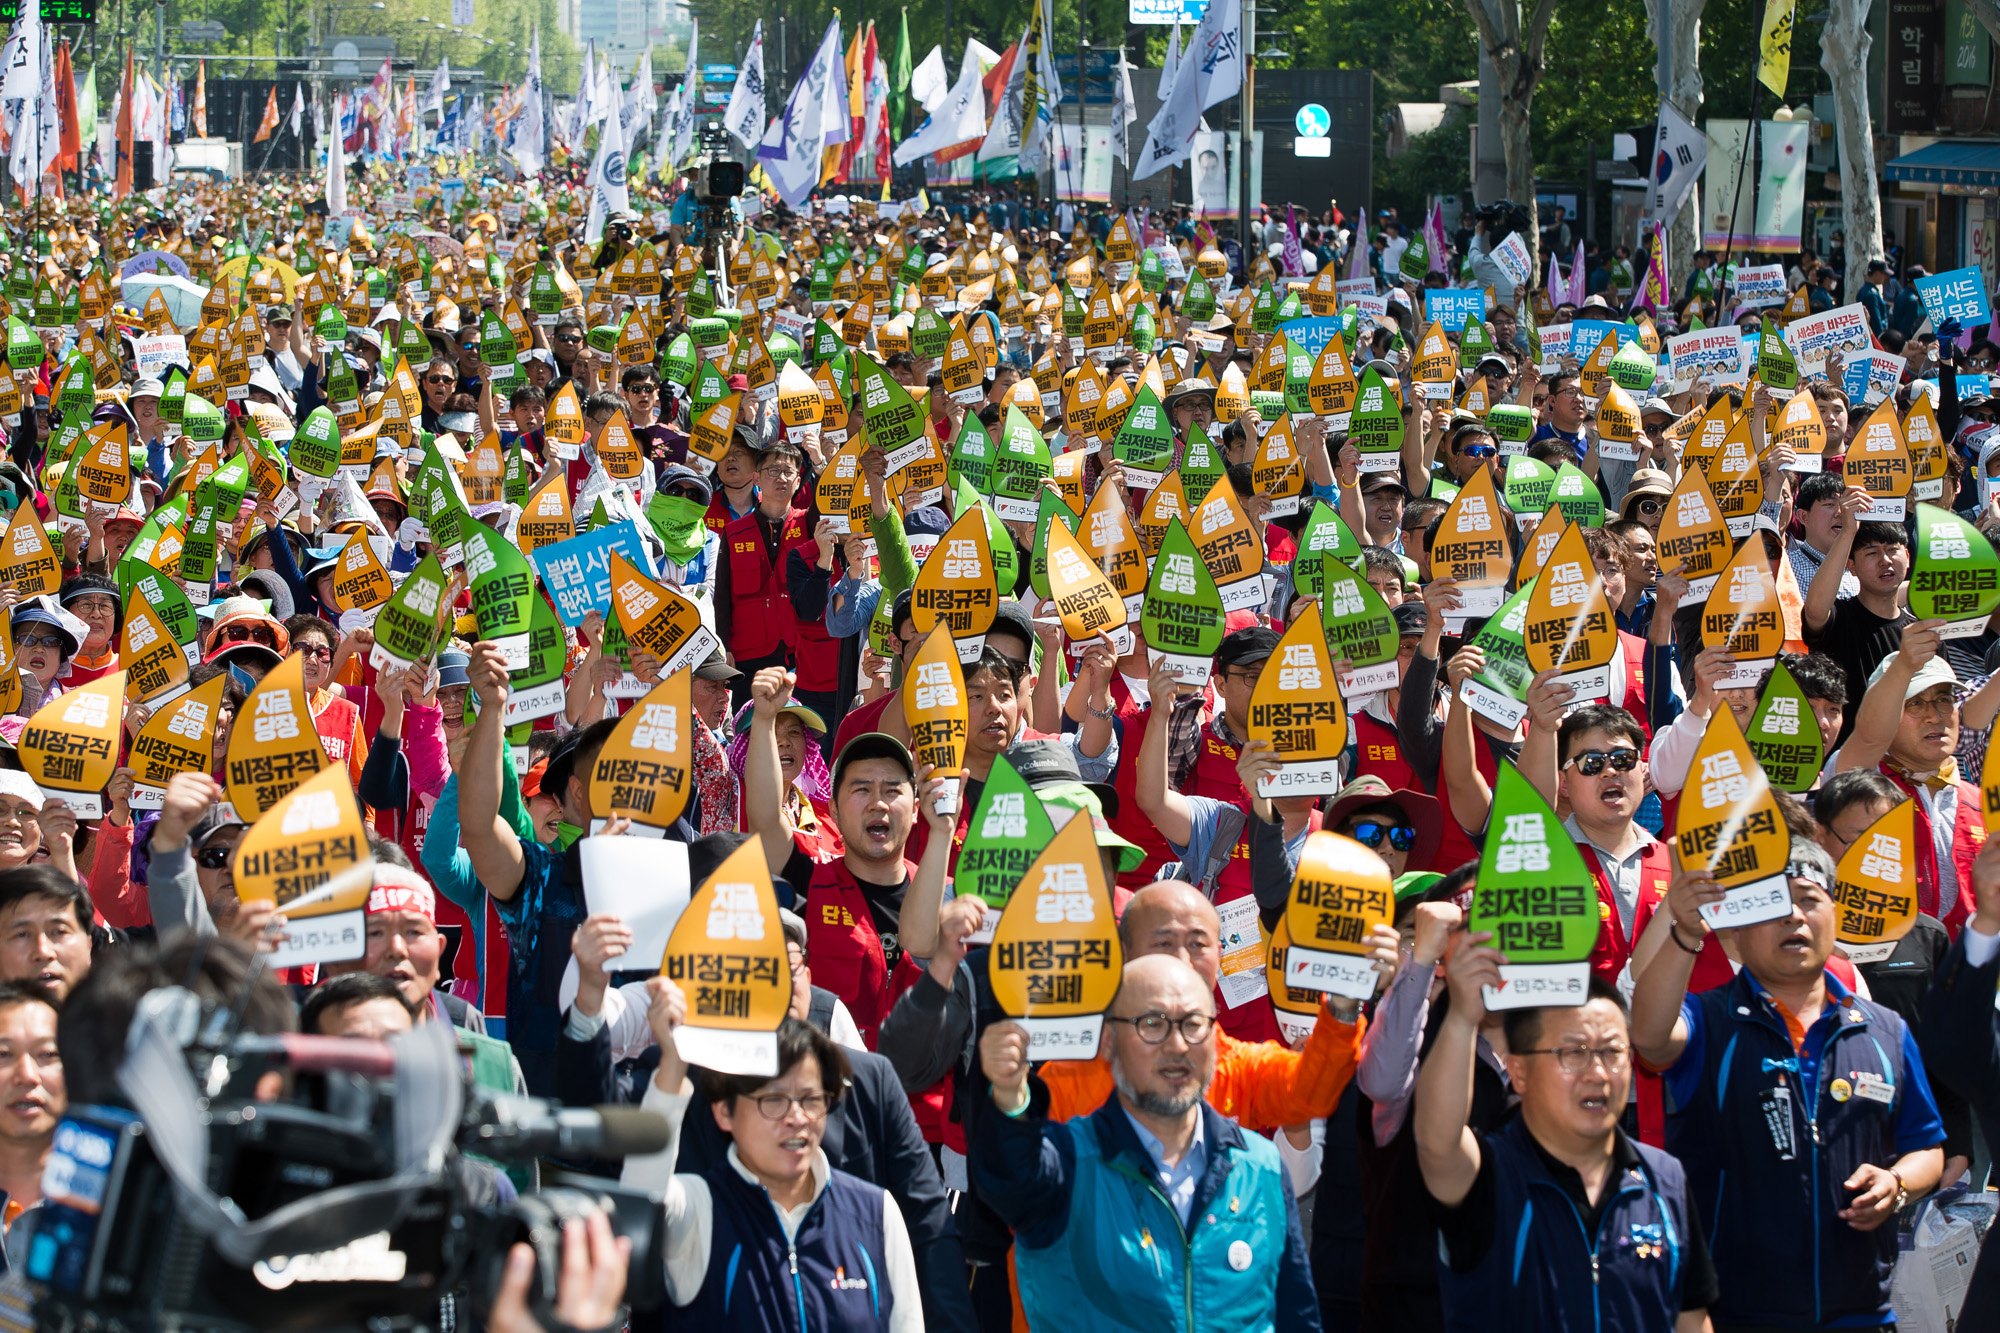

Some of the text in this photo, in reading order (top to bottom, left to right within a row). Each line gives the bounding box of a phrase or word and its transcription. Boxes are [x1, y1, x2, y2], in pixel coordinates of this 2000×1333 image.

[1901, 27, 1925, 85] 학림
[1431, 297, 1480, 311] 불법 사드
[1921, 280, 1978, 308] 불법 사드
[1948, 300, 1982, 321] 무효
[1309, 325, 1335, 344] 사드
[1576, 328, 1602, 344] 불법
[1797, 314, 1861, 339] 세상을 바꾸는
[1800, 325, 1864, 348] 공공운수노동자
[481, 340, 514, 355] 최저임금
[951, 348, 970, 361] 당장
[1673, 335, 1737, 356] 세상을 바꾸는
[1674, 347, 1739, 369] 공공운수노동자
[942, 359, 979, 380] 비정규직
[1413, 356, 1451, 375] 비정규직
[1760, 356, 1794, 374] 최저임금
[865, 389, 891, 409] 당장
[1310, 380, 1355, 399] 비정규직
[1363, 386, 1383, 400] 지금
[545, 418, 582, 431] 비정규직
[865, 403, 915, 433] 최저임금
[1351, 416, 1399, 433] 최저임금
[103, 441, 122, 456] 지금
[294, 438, 338, 462] 최저임금
[961, 441, 985, 457] 당장
[1118, 433, 1170, 453] 최저임금
[1723, 442, 1747, 457] 지금
[98, 452, 122, 468] 당장
[609, 462, 630, 474] 철폐
[996, 458, 1050, 479] 최저임금
[1721, 456, 1750, 473] 당장
[1847, 458, 1907, 476] 비정규직
[79, 466, 125, 488] 비정규직
[1863, 476, 1893, 492] 철폐
[520, 522, 570, 537] 비정규직
[1202, 510, 1236, 535] 당장
[13, 537, 43, 556] 당장
[182, 539, 213, 559] 최저임금
[464, 532, 489, 561] 지금
[735, 542, 756, 553] 단결
[1434, 540, 1503, 564] 비정규직
[1659, 529, 1725, 559] 비정규직
[1053, 545, 1079, 569] 지금
[336, 568, 385, 595] 비정규직
[545, 553, 585, 592] 불법
[1915, 568, 1998, 592] 최저임금
[351, 587, 378, 608] 철폐
[557, 583, 595, 619] 원천
[1058, 581, 1114, 617] 비정규직
[1332, 578, 1361, 600] 지금
[1550, 582, 1594, 608] 당장
[1146, 597, 1217, 628] 최저임금
[1932, 593, 1980, 615] 1만원
[629, 600, 684, 649] 비정규직
[1080, 606, 1112, 632] 철폐
[1326, 616, 1391, 645] 최저임금
[1528, 612, 1608, 645] 비정규직
[1706, 612, 1776, 633] 비정규직
[129, 628, 159, 654] 당장
[650, 624, 685, 656] 철폐
[1157, 622, 1200, 648] 1만원
[137, 667, 171, 694] 철폐
[916, 661, 953, 686] 지금
[256, 689, 292, 714] 지금
[915, 683, 959, 711] 당장
[1767, 696, 1799, 716] 지금
[253, 711, 300, 742] 당장
[639, 703, 677, 729] 지금
[1252, 701, 1336, 728] 비정규직
[1761, 715, 1801, 735] 당장
[167, 716, 205, 741] 당장
[631, 724, 679, 752] 당장
[1272, 728, 1317, 753] 철폐
[24, 727, 112, 760] 비정규직
[134, 734, 207, 771] 비정규직
[1367, 745, 1396, 761] 단결
[42, 756, 86, 783] 철폐
[230, 749, 320, 786] 비정규직
[596, 758, 686, 793] 비정규직
[1023, 758, 1059, 771] Columbia
[1700, 749, 1740, 781] 지금
[1279, 770, 1334, 786] 민주노총
[610, 785, 657, 815] 철폐
[1701, 773, 1752, 809] 당장
[988, 792, 1025, 816] 지금
[981, 812, 1028, 839] 당장
[1501, 813, 1546, 844] 지금
[1680, 809, 1777, 858] 비정규직
[243, 836, 357, 877] 비정규직
[1495, 843, 1551, 873] 당장
[1867, 833, 1903, 860] 지금
[1040, 864, 1088, 892] 지금
[1860, 853, 1903, 884] 당장
[711, 882, 758, 911] 지금
[1035, 892, 1095, 924] 당장
[1296, 879, 1388, 917] 비정규직
[1477, 886, 1586, 919] 최저임금
[706, 911, 765, 941] 당장
[1315, 912, 1365, 945] 철폐
[1840, 909, 1885, 937] 철폐
[998, 939, 1111, 971] 비정규직
[668, 954, 779, 987] 비정규직
[1026, 973, 1083, 1005] 철폐
[696, 985, 750, 1019] 철폐
